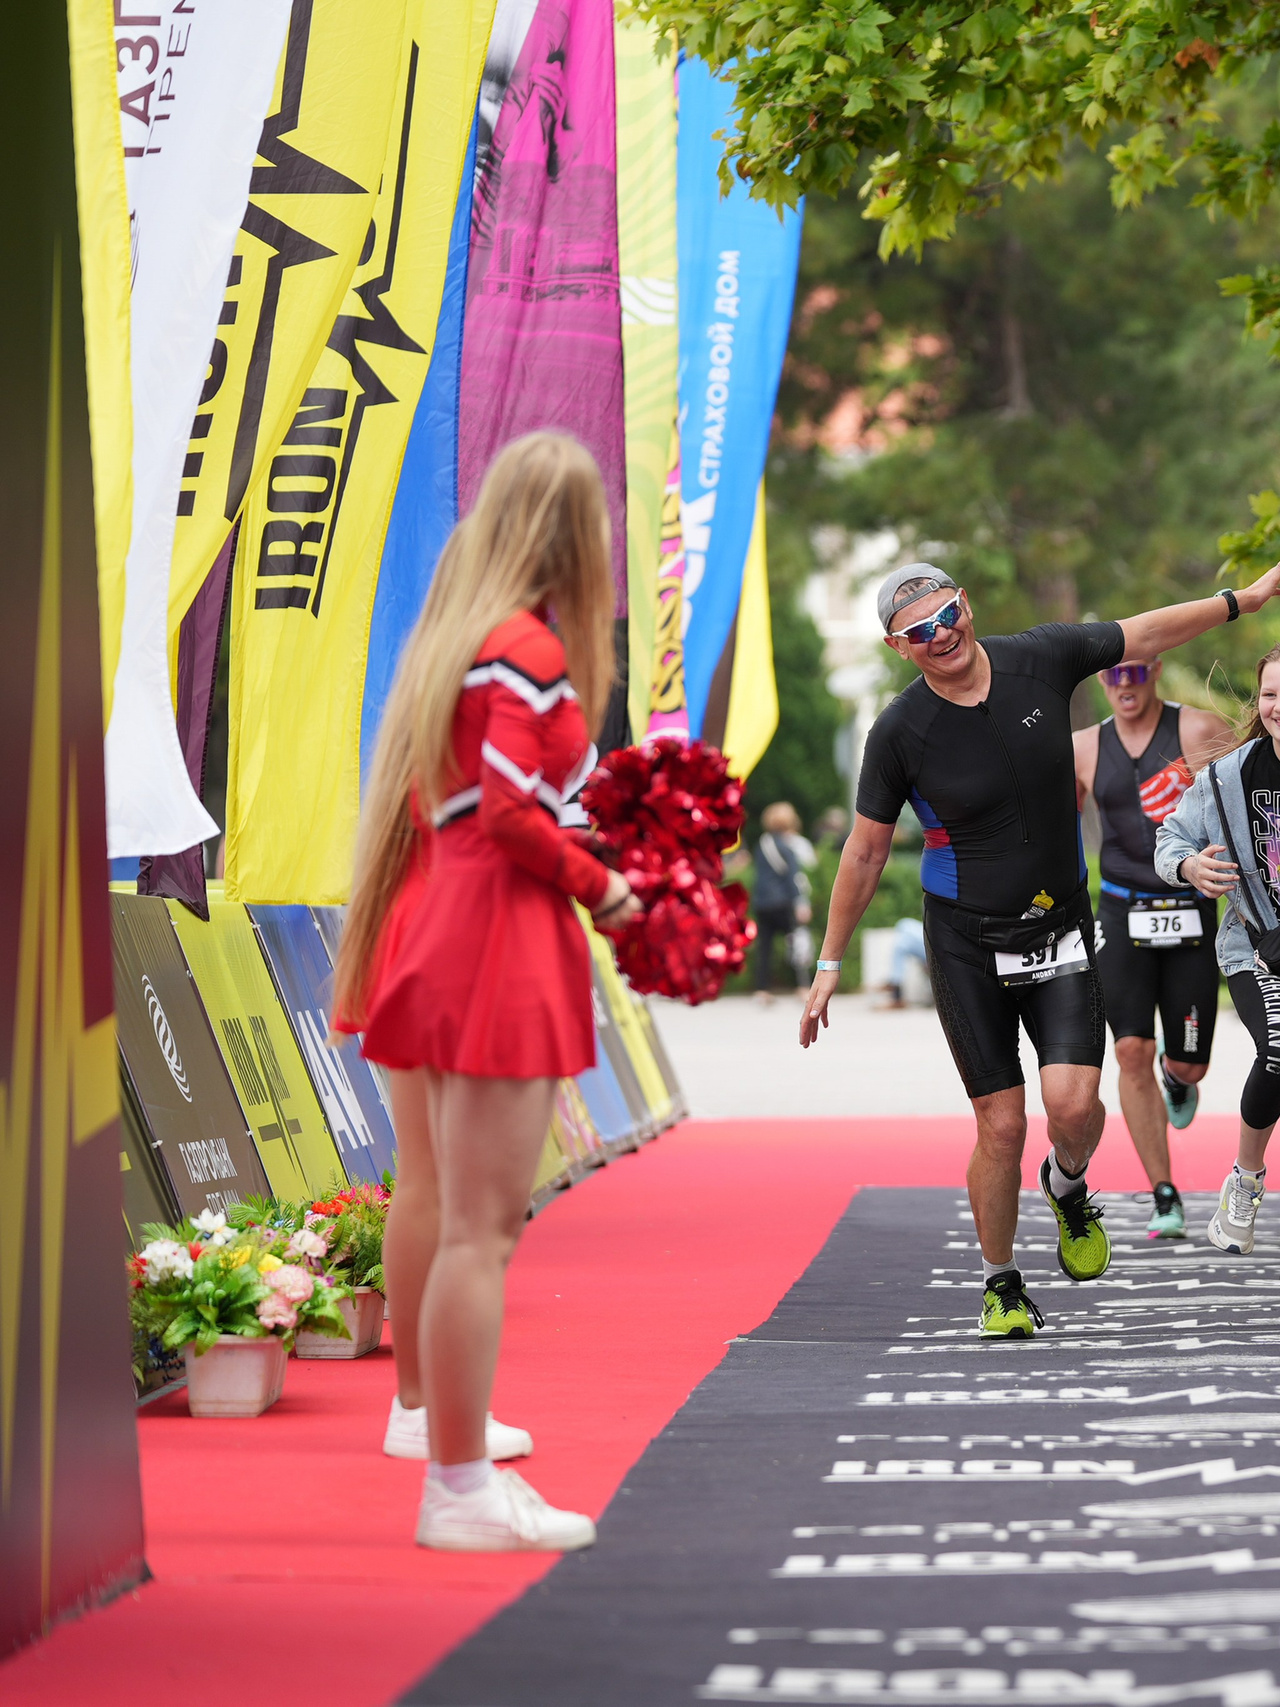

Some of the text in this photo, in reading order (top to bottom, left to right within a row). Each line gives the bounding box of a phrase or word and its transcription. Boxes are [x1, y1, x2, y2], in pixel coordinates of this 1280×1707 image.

[699, 250, 740, 487] СТРАХОВОЙ ДОМ
[255, 388, 348, 610] IRON
[1022, 708, 1043, 728] TYR
[1150, 917, 1181, 933] 376
[1032, 968, 1056, 980] ANDREY
[863, 1386, 1131, 1402] IRON
[832, 1459, 1136, 1475] IRON
[782, 1550, 1138, 1572] IRON
[706, 1663, 1136, 1696] IRON
